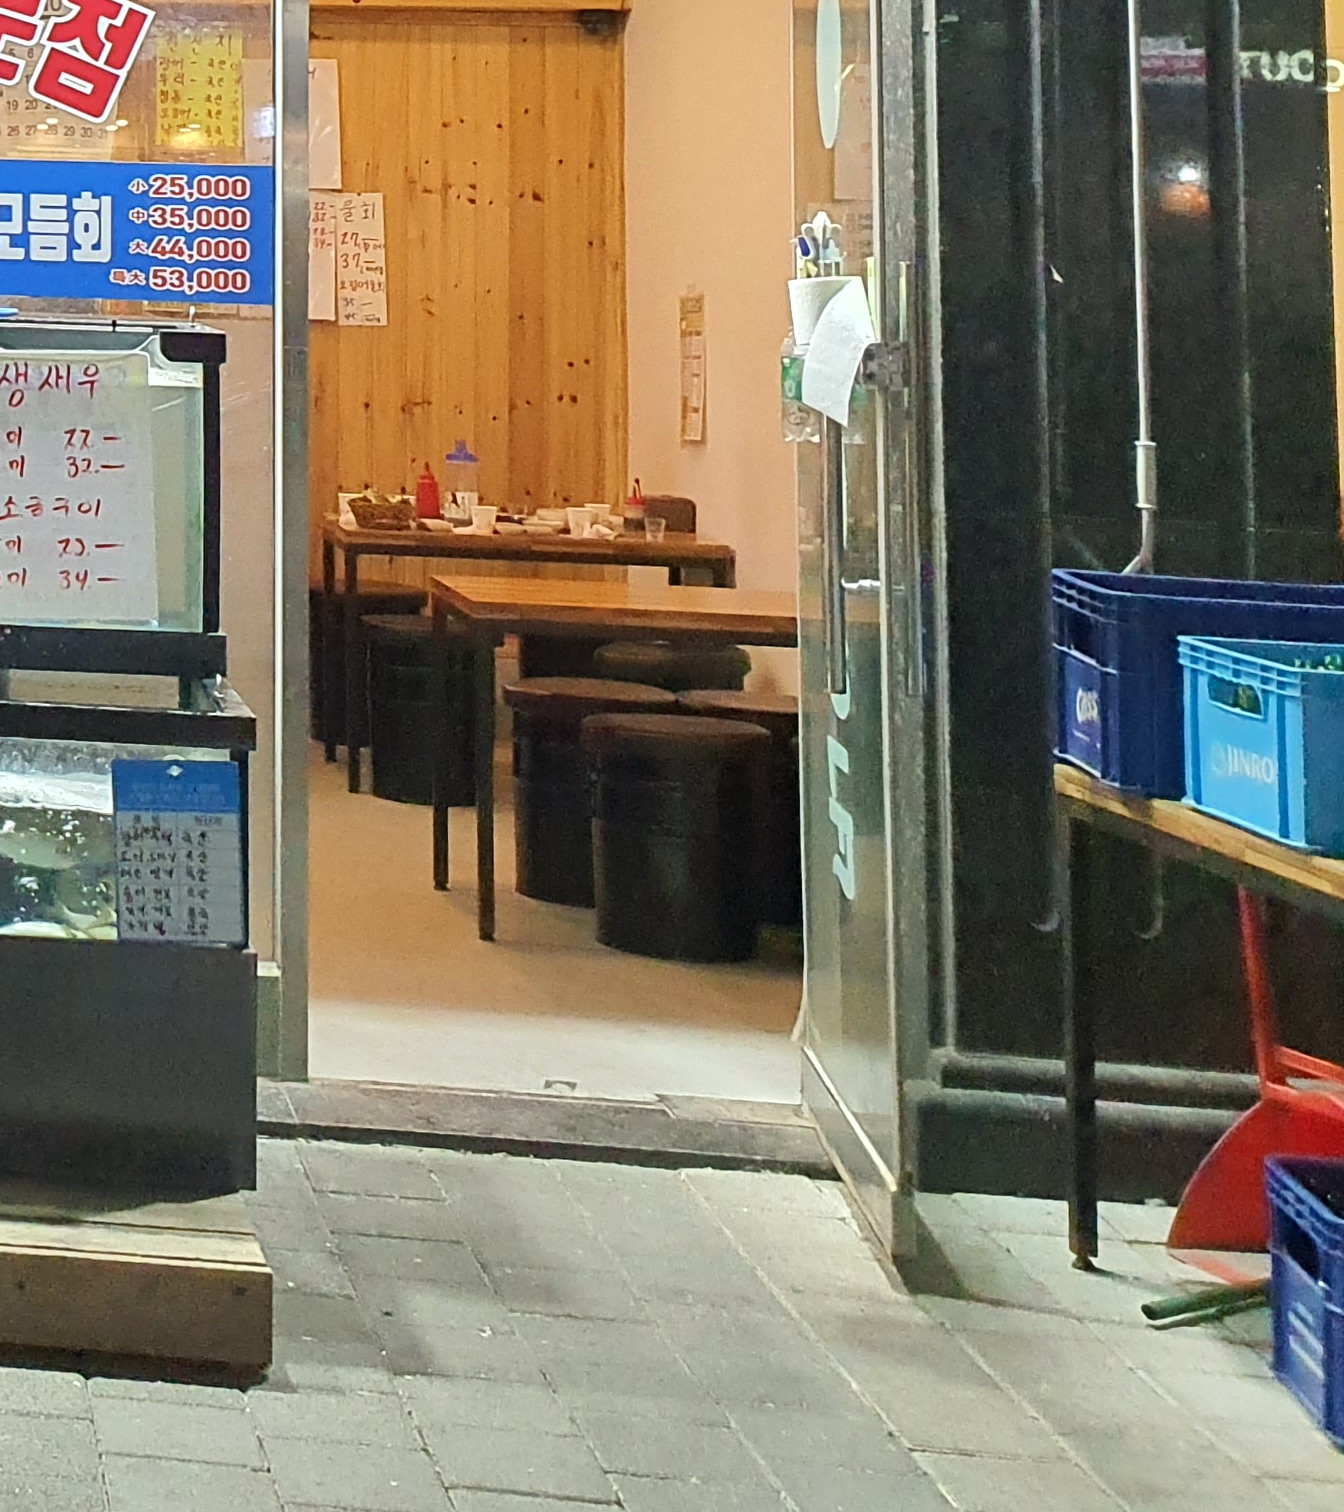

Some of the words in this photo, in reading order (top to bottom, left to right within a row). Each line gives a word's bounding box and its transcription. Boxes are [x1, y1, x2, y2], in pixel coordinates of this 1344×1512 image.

[6, 99, 19, 111] 19
[25, 99, 38, 111] 20
[63, 125, 76, 137] 29
[80, 126, 93, 138] 30
[1226, 743, 1275, 784] JINRO
